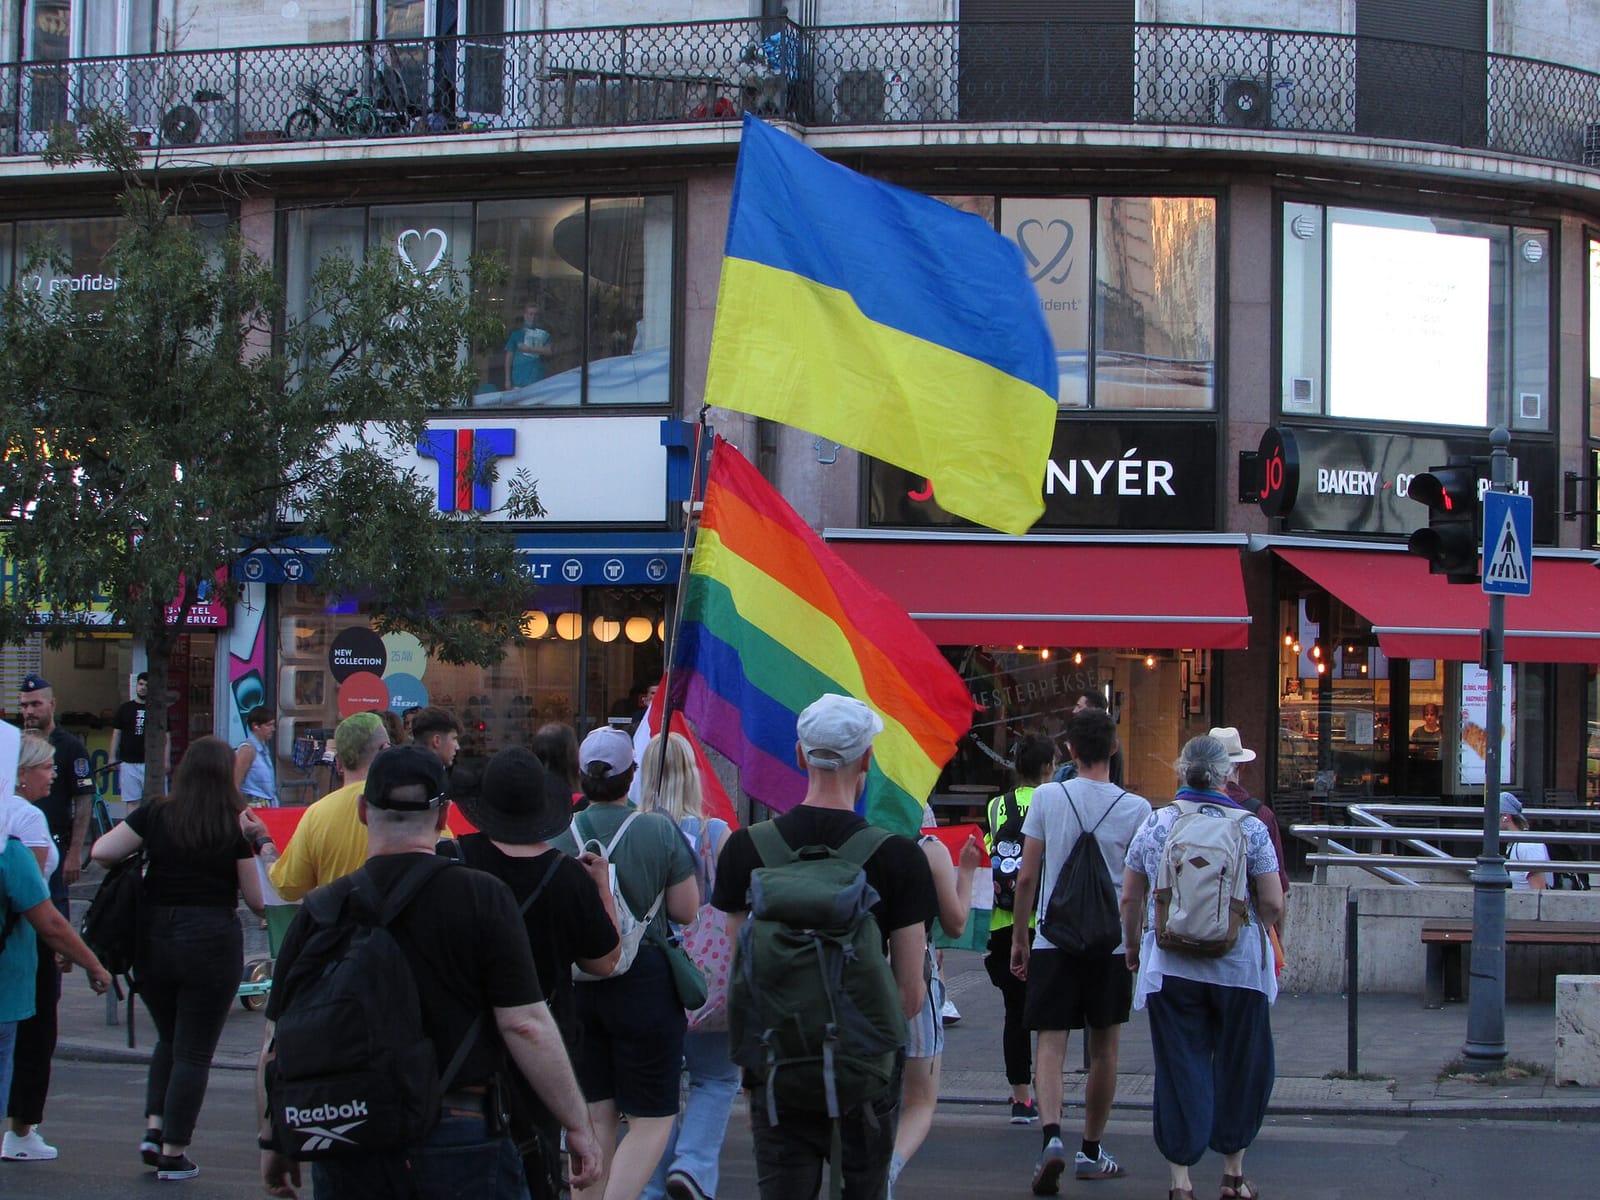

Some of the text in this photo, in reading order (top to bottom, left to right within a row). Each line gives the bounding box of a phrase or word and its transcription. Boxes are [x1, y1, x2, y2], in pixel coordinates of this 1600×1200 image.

[1040, 298, 1078, 311] ident
[1045, 447, 1177, 496] NYÉR
[1260, 446, 1283, 499] JÓ
[1317, 468, 1379, 496] BAKERY
[334, 649, 353, 657] NEW
[334, 657, 382, 665] COLLECTION
[285, 1099, 369, 1127] Reebok
